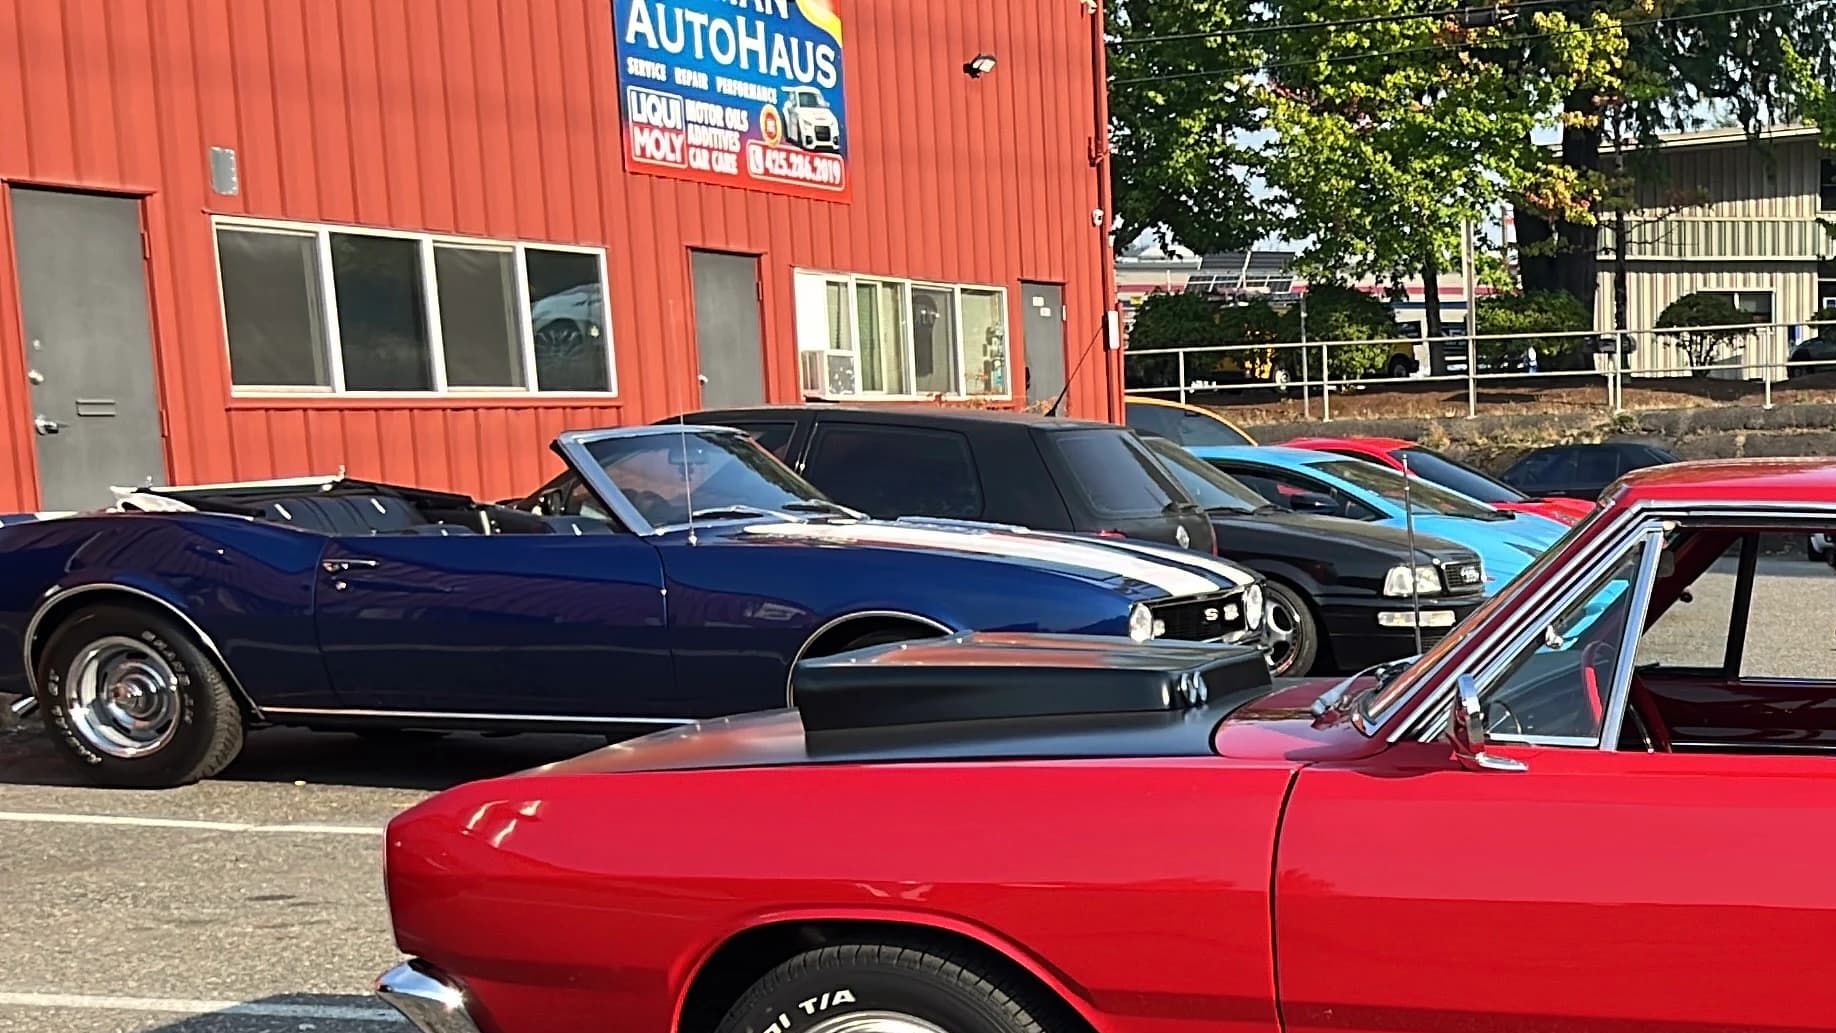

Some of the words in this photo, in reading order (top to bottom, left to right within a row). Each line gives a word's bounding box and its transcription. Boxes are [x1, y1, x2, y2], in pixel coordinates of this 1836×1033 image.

[627, 57, 667, 82] SERVICE
[674, 67, 709, 90] REPAIR
[715, 76, 778, 105] PERFORMANCE
[630, 90, 683, 130] LIQUI
[685, 99, 724, 127] MOTOR
[725, 107, 749, 132] OILS
[634, 126, 685, 163] MOLY
[687, 124, 741, 152] ADDITIVES
[689, 148, 711, 171] CAR
[711, 151, 739, 175] CARE
[798, 988, 856, 1016] T/A
